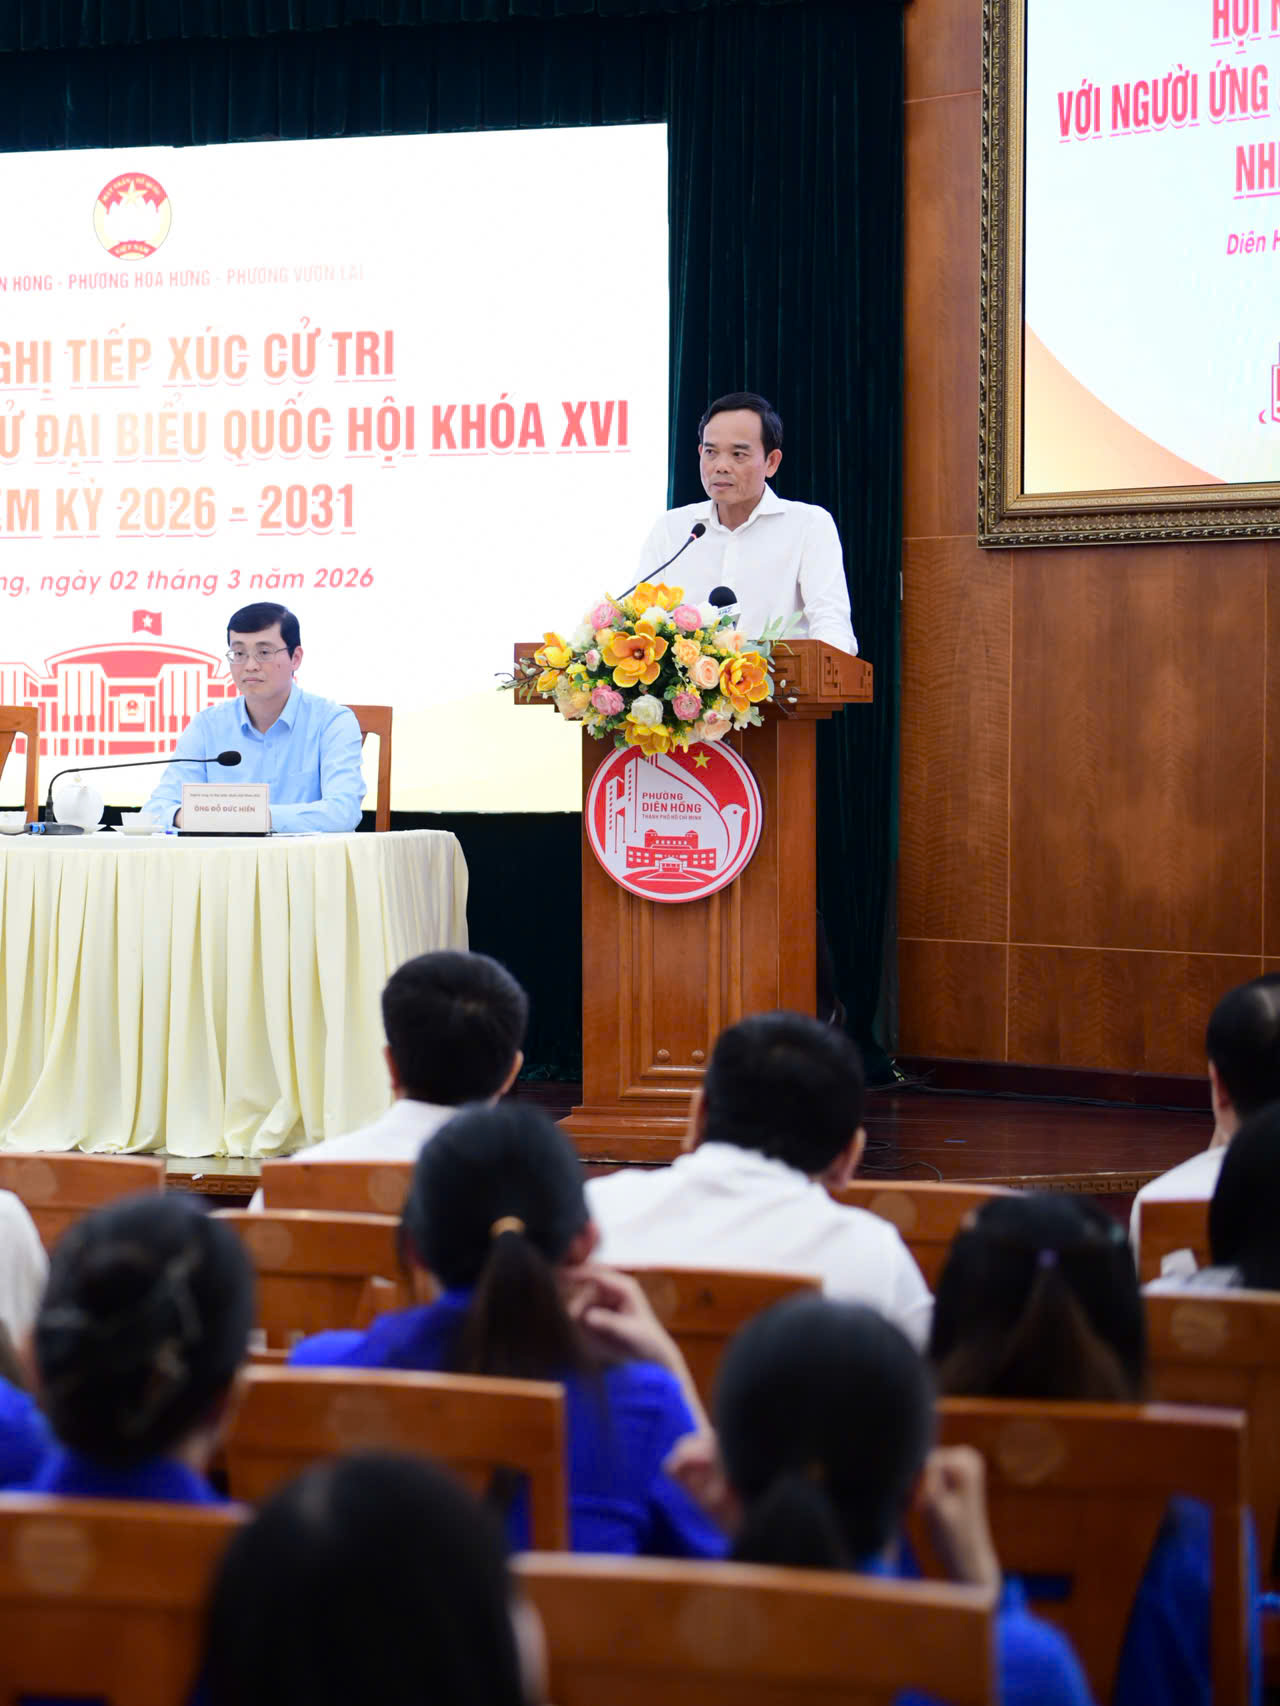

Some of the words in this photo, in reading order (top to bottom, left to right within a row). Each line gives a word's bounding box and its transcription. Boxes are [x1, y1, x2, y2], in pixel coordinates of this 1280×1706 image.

[1058, 78, 1101, 137] VỚI
[1112, 63, 1199, 130] NGƯỜI
[1210, 59, 1269, 118] ỨNG
[1236, 141, 1280, 192] NH
[1226, 230, 1266, 255] Diên
[66, 322, 152, 383] TIẾP
[168, 325, 248, 380] XÚC
[264, 315, 322, 379] CỬ
[331, 330, 394, 376] TRI
[35, 413, 101, 468] ĐẠI
[117, 392, 208, 456] BIỂU
[223, 391, 332, 460] QUỐC
[348, 395, 416, 462] HỘI
[431, 392, 545, 450] KHÓA
[560, 400, 628, 447] XVI
[55, 477, 104, 532] KỲ
[118, 485, 217, 532] 2026
[260, 483, 354, 530] 2031
[40, 568, 102, 598] ngày
[109, 570, 139, 591] 02
[146, 568, 219, 597] tháng
[227, 569, 241, 590] 3
[249, 567, 305, 590] năm
[313, 567, 375, 589] 2026
[642, 801, 668, 812] DIÊN
